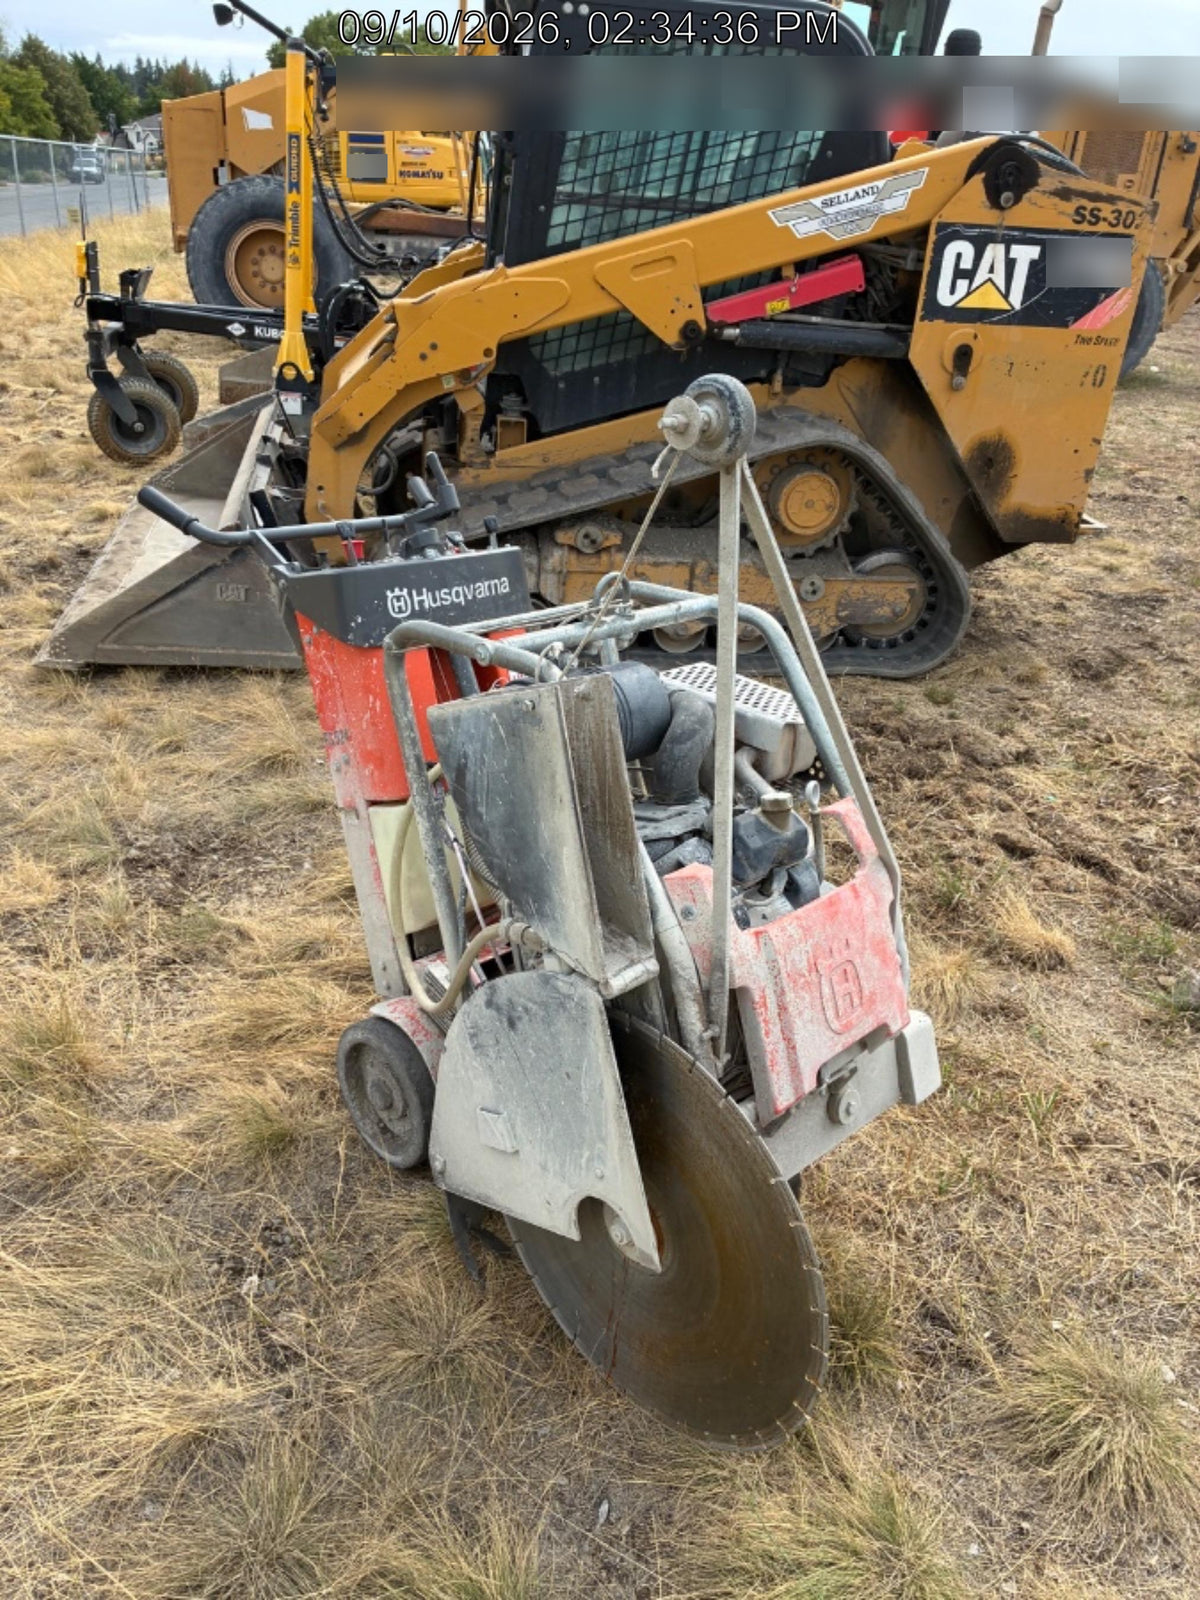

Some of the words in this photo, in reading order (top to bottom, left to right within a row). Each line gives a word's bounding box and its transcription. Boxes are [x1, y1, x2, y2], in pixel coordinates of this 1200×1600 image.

[398, 169, 444, 180] KOMATSU
[820, 185, 880, 209] SELLAND
[289, 201, 300, 249] Trimble
[936, 239, 1042, 311] CAT
[412, 576, 510, 612] Husqvarna
